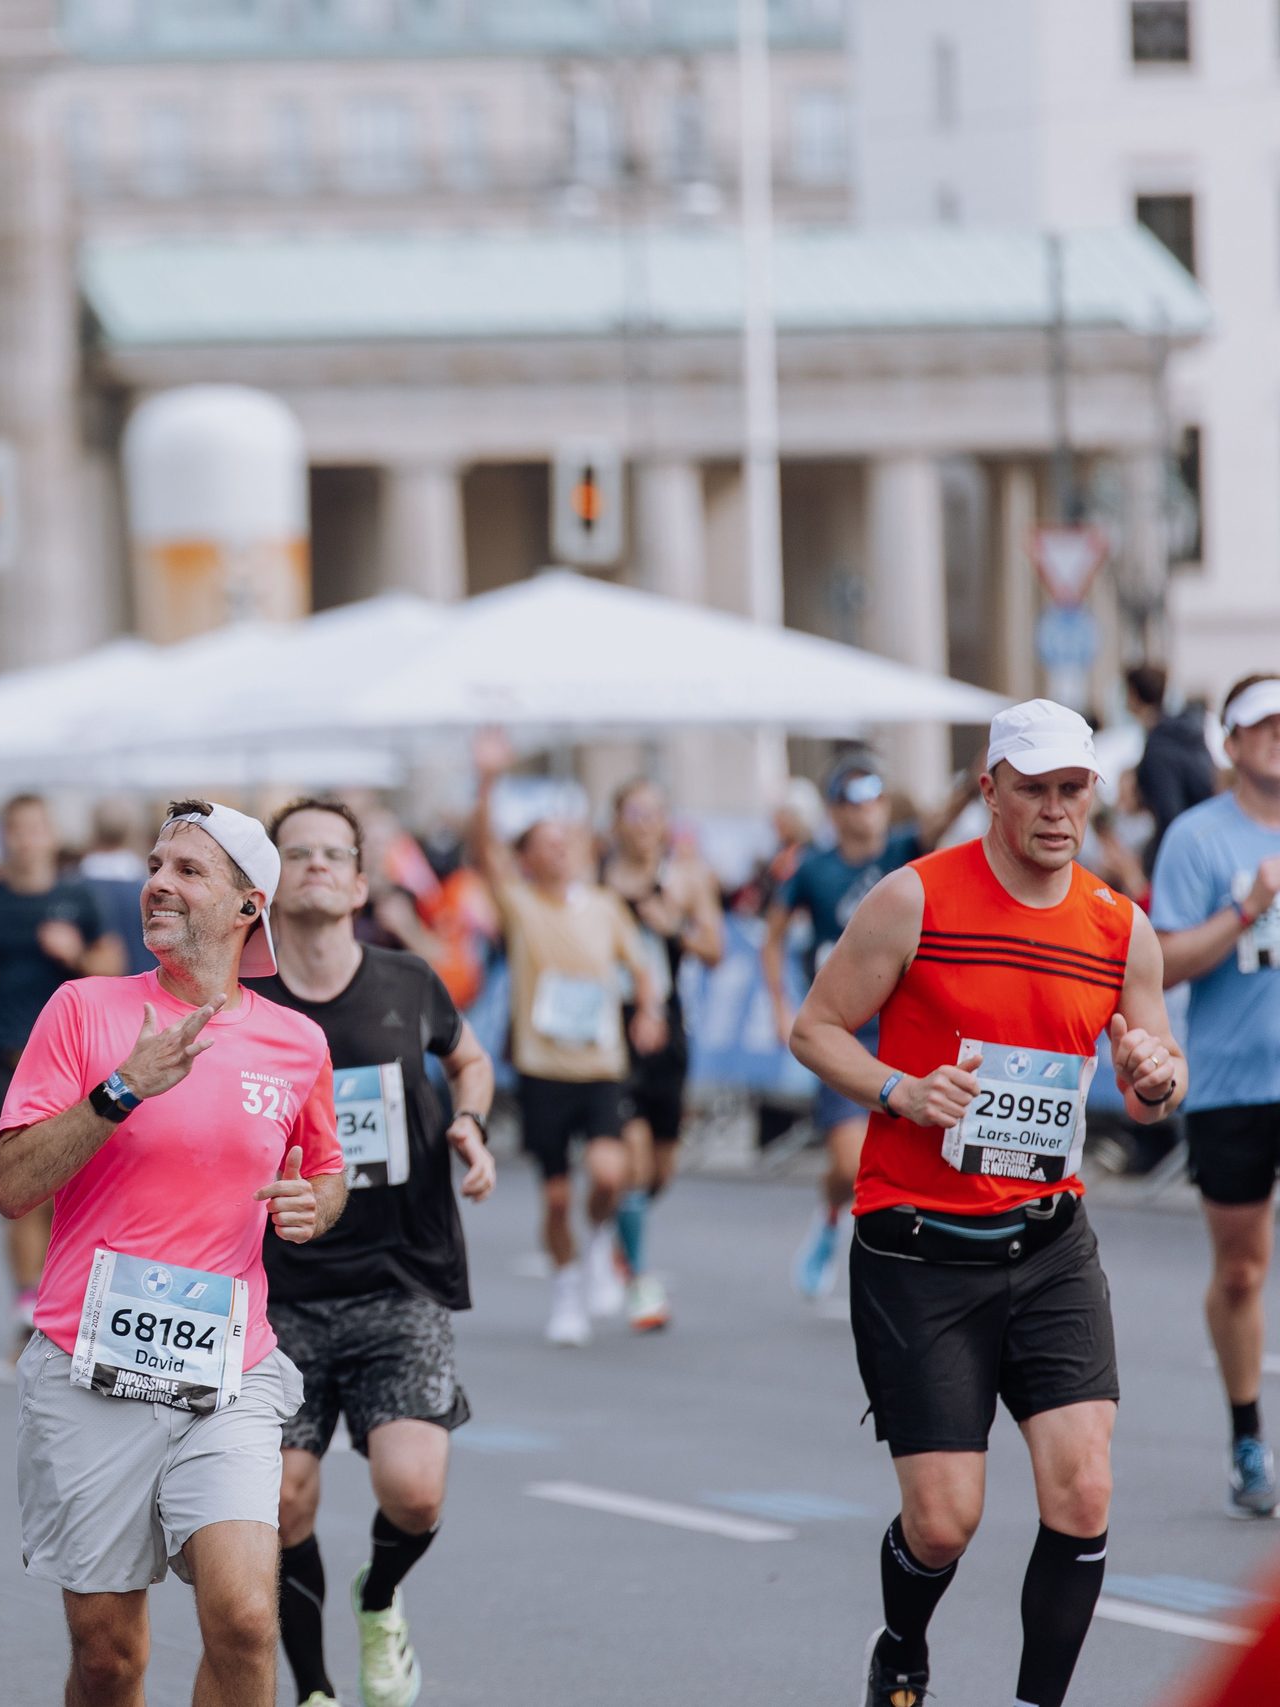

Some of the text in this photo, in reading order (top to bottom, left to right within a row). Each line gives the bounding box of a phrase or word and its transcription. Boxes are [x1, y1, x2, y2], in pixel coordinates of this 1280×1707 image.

[241, 1071, 293, 1090] MANHATTAN
[976, 1090, 1072, 1127] 29958
[336, 1111, 376, 1136] 34
[977, 1125, 1062, 1149] Lars-Oliver
[981, 1160, 990, 1174] IS
[990, 1161, 1030, 1179] NOTHING
[982, 1147, 1036, 1168] IMPOSSIBLE
[84, 1329, 96, 1365] September
[91, 1310, 100, 1328] 2022
[111, 1309, 216, 1354] 68184
[233, 1325, 241, 1337] E
[135, 1349, 185, 1373] David
[112, 1383, 172, 1405] IS NOTHING
[116, 1370, 179, 1396] IMPOSSIBLE
